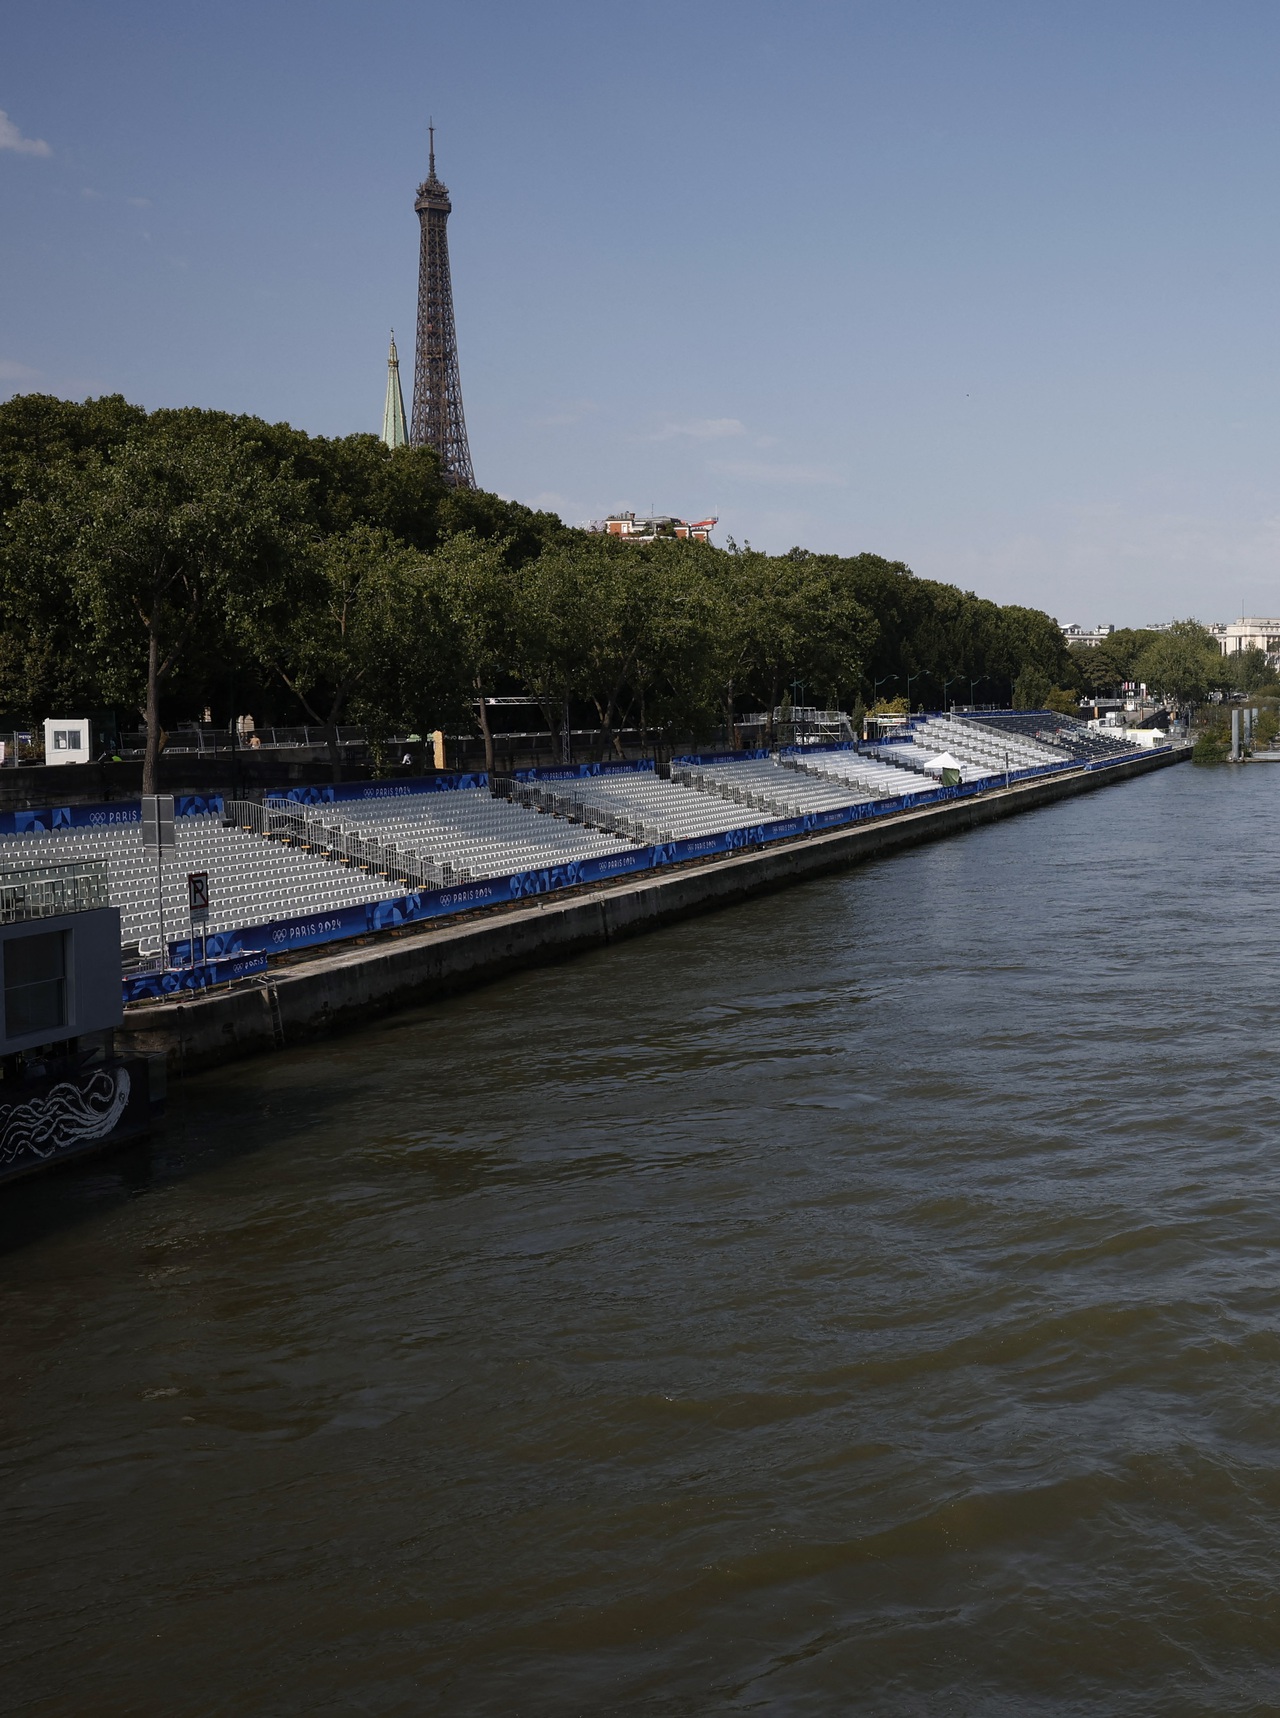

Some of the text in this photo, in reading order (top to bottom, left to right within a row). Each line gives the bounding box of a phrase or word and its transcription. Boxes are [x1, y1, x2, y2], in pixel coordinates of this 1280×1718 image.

[375, 786, 411, 797] PARIS 2024
[109, 810, 137, 822] PARIS
[608, 859, 622, 869] PARIS
[453, 887, 492, 904] PARIS 2024
[289, 918, 342, 939] PARIS 2024
